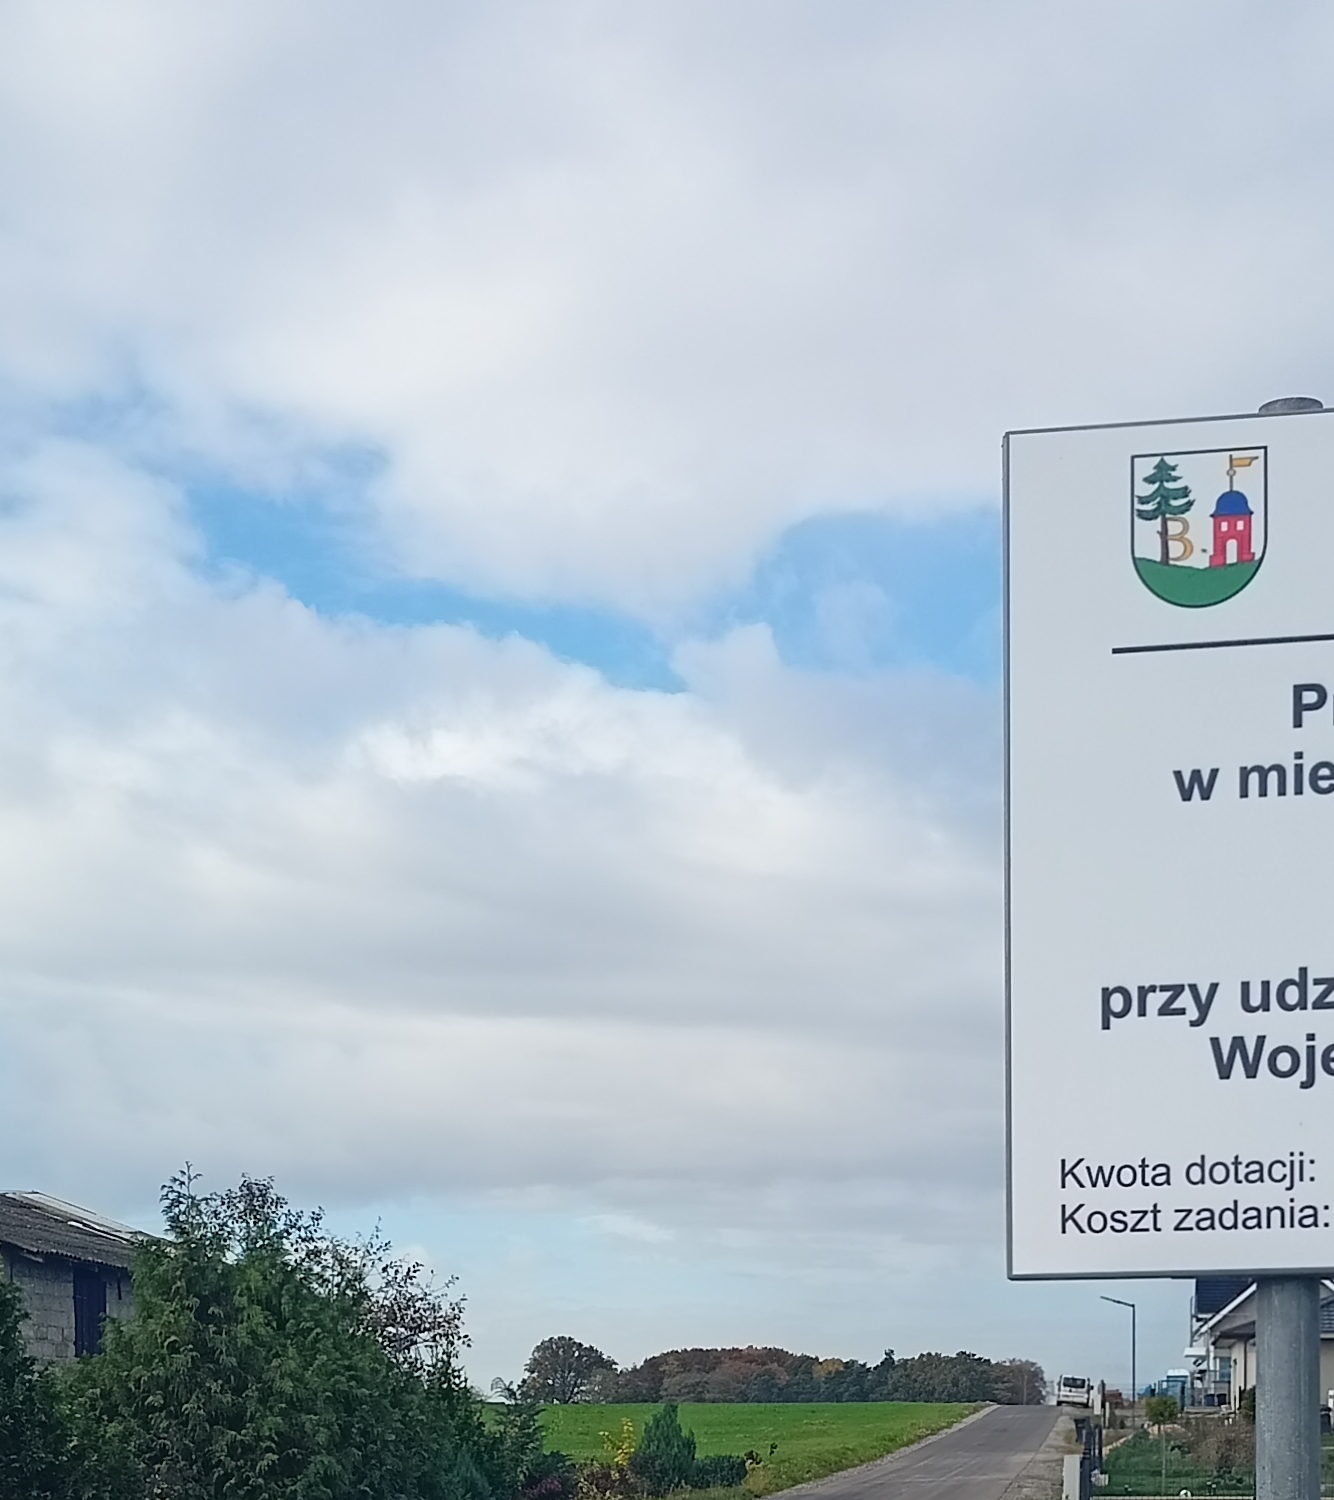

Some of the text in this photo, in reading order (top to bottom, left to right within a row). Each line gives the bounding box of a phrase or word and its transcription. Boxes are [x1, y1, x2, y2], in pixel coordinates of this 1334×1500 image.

[1172, 767, 1220, 803] w
[1100, 981, 1220, 1031] przy
[1060, 1156, 1172, 1190] Kwota
[1184, 1150, 1316, 1192] dotacji:
[1060, 1202, 1163, 1235] Koszt
[1172, 1197, 1330, 1232] zadania:
